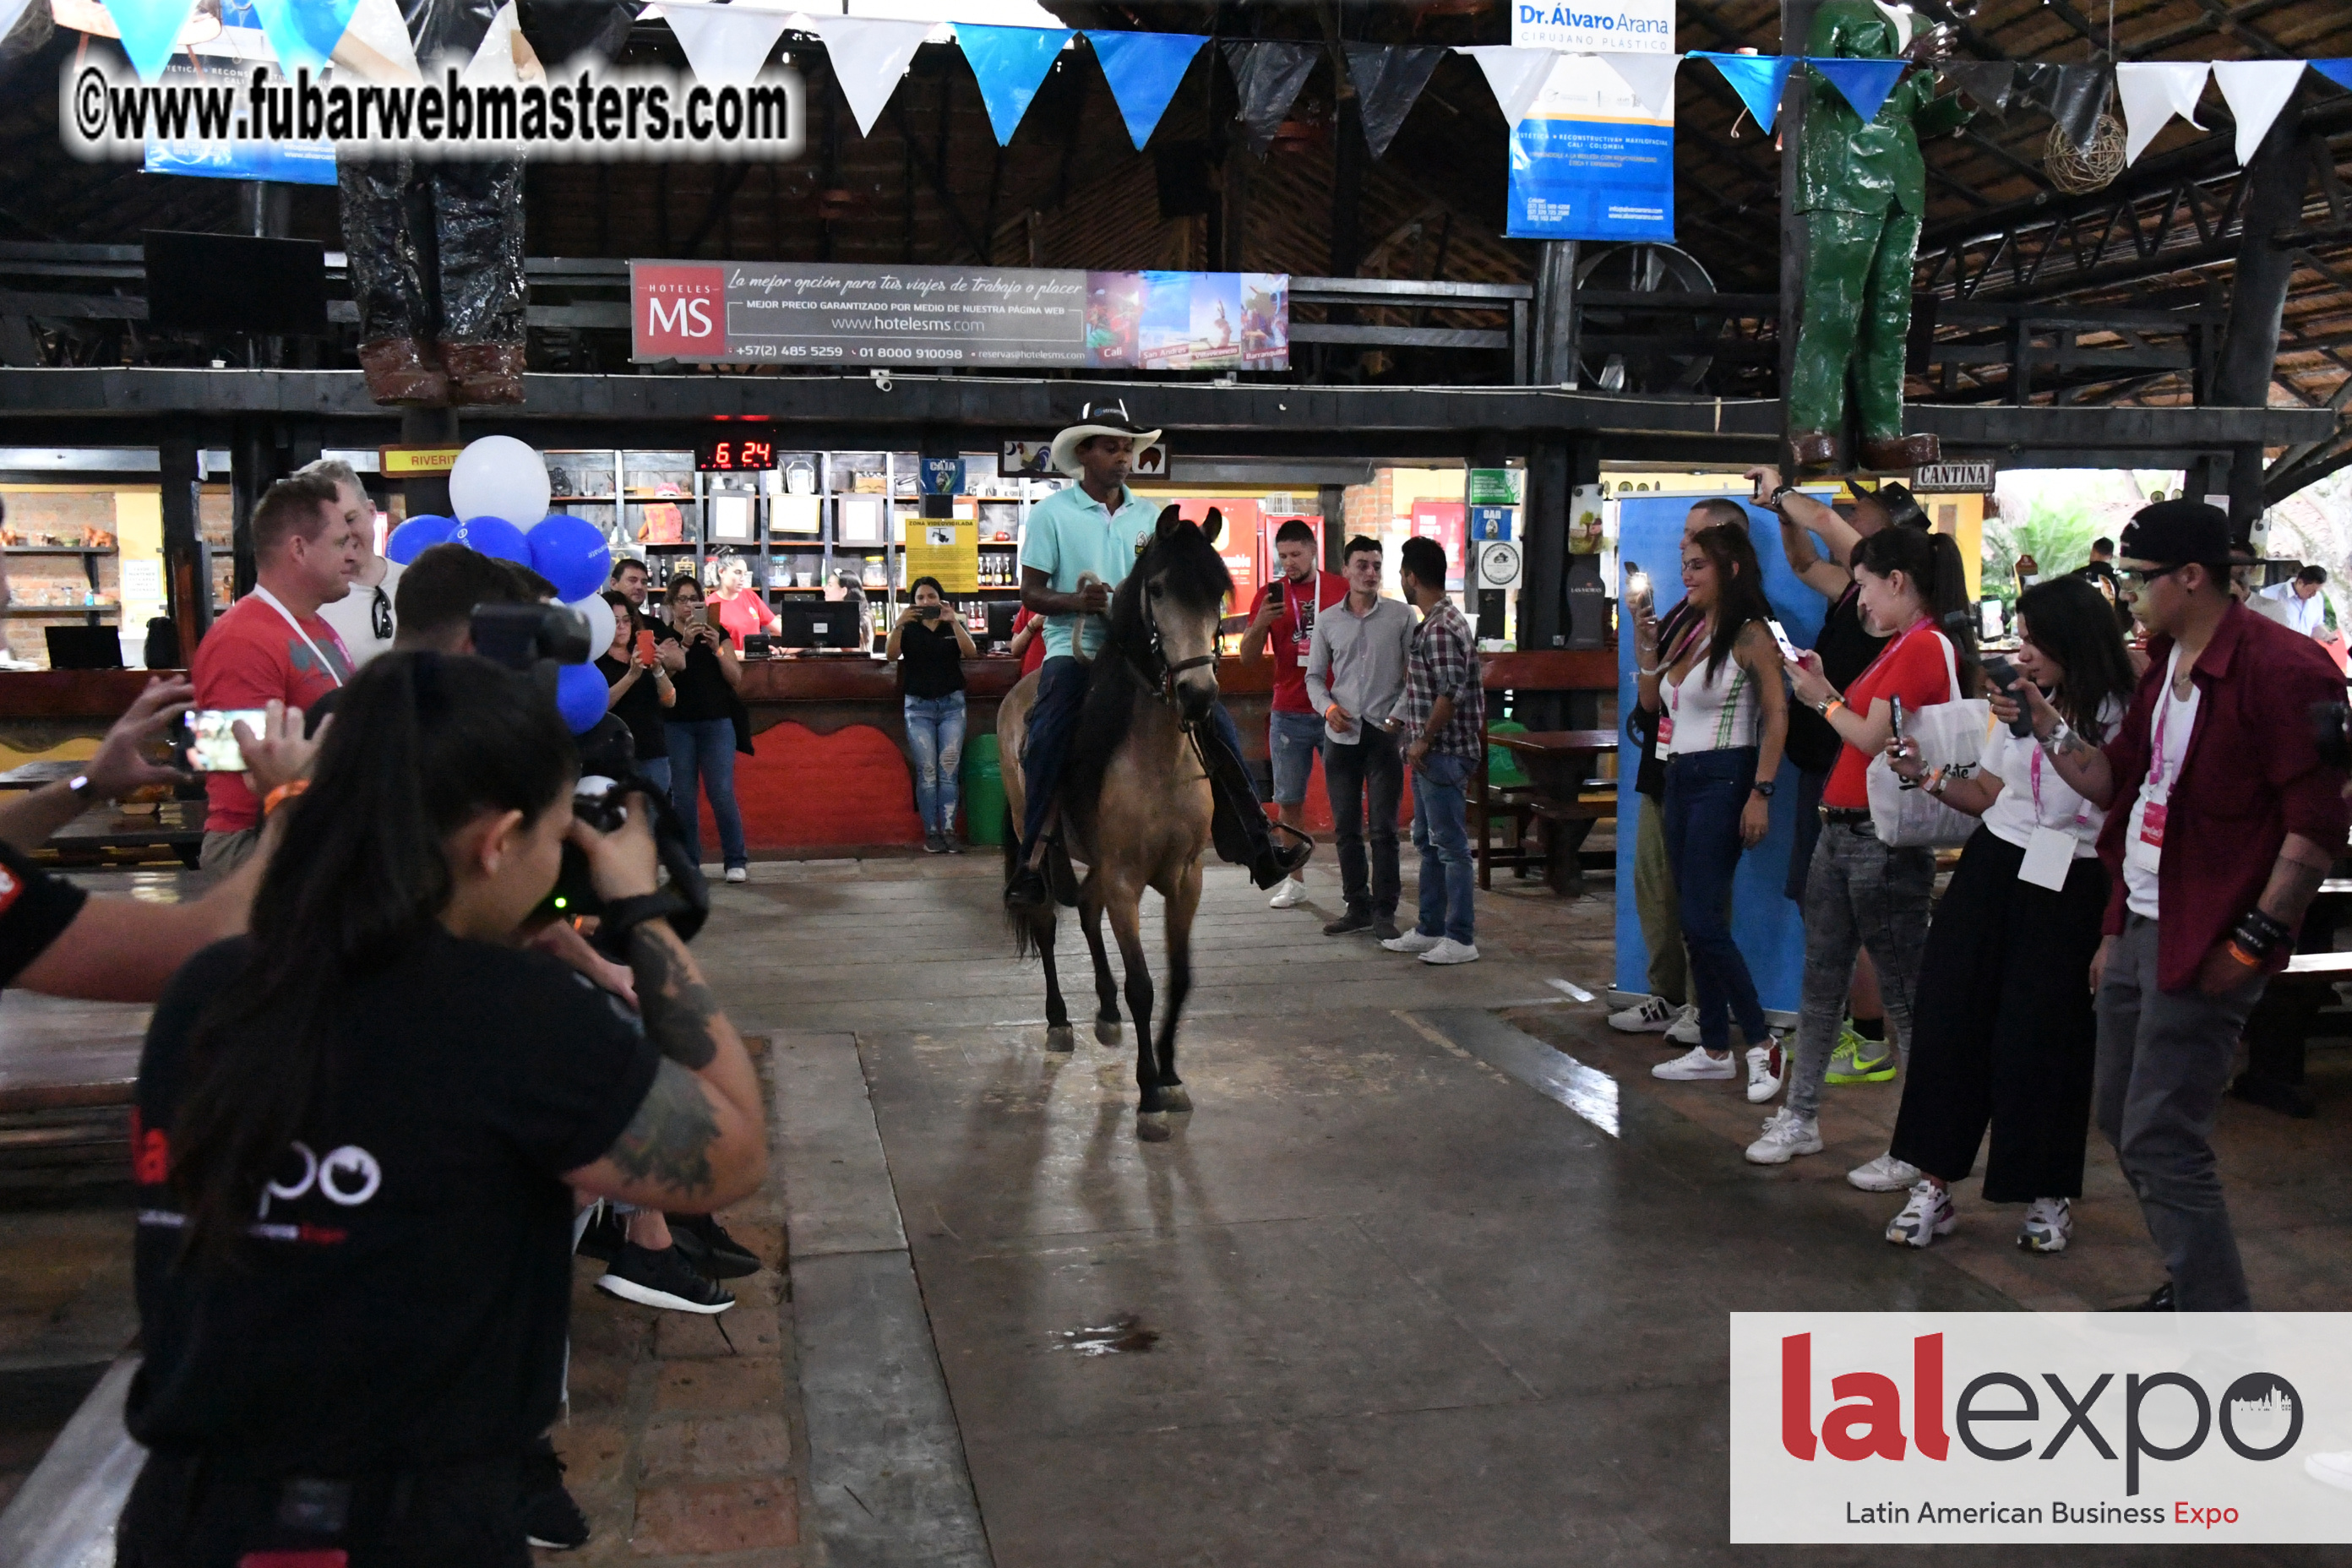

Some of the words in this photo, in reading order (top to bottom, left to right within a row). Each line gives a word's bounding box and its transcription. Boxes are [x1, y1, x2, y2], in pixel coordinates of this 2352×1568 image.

[1519, 5, 1549, 24] Dr.
[1552, 3, 1614, 30] Álvaro
[1615, 13, 1669, 35] Arana
[1521, 31, 1593, 46] CIRUJANO
[166, 64, 197, 74] TÉTICA
[1559, 133, 1619, 144] RECONSTRUCTIVA
[1625, 137, 1669, 147] MAXILOFACIAL
[1589, 142, 1625, 150] COLOMBIA
[649, 284, 711, 294] HOTELES
[727, 268, 745, 289] La
[749, 274, 792, 295] mejor
[794, 275, 840, 296] opción
[839, 279, 878, 297] para
[880, 274, 902, 291] tus
[906, 278, 946, 298] viajes
[950, 276, 969, 292] de
[972, 276, 1022, 300] trabajo
[1025, 283, 1035, 293] o
[1033, 278, 1083, 301] placer
[747, 299, 779, 310] MEJOR
[781, 300, 818, 310] PRECIO
[819, 301, 888, 312] GARANTIZADO
[890, 302, 912, 312] POR
[913, 302, 945, 313] MEDIO
[947, 304, 961, 313] DE
[962, 304, 1006, 315] NUESTRA
[1008, 303, 1043, 315] PÁGINA
[1043, 306, 1065, 315] WEB
[648, 297, 713, 338] MS
[831, 315, 985, 333] www.hotelesms.com
[736, 345, 777, 358] +57(2)
[781, 346, 807, 357] 485
[810, 346, 843, 357] 5259
[859, 347, 874, 358] 01
[877, 347, 912, 358] 8000
[916, 348, 963, 359] 910098
[977, 349, 1086, 361] reservas@hotelesms.com
[1103, 347, 1123, 358] Cali
[1143, 349, 1158, 361] San
[1194, 347, 1239, 359] Villavicencio
[1245, 348, 1288, 361] Barranquilla
[716, 442, 730, 464] 6
[742, 442, 770, 463] 24
[411, 455, 458, 466] RIVERIT
[929, 461, 956, 471] CAJA
[1920, 466, 1986, 484] CANTINA
[1483, 509, 1502, 520] BAR
